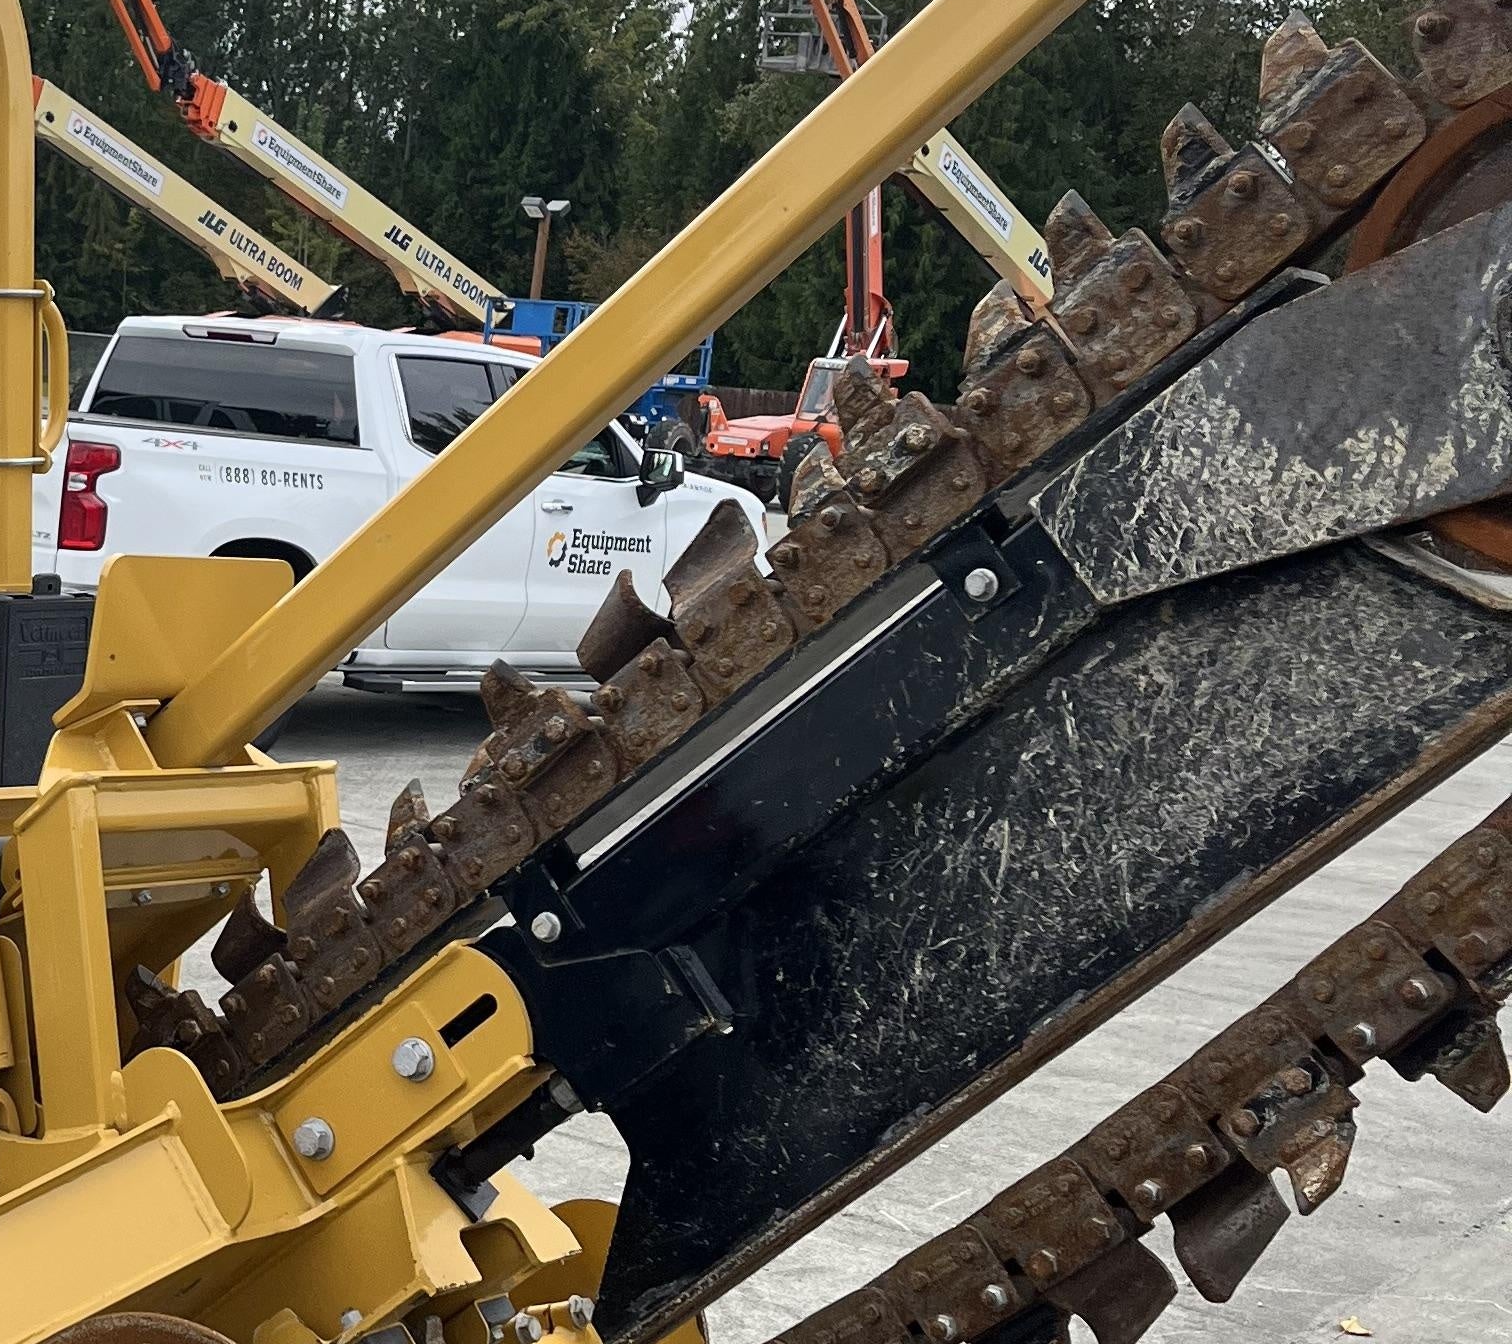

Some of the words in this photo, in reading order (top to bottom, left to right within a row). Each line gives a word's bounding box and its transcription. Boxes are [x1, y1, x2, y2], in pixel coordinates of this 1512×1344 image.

[83, 126, 158, 188] EquipmentShare
[268, 136, 342, 200] EquipmentShare
[951, 160, 1009, 231] EquipmentShare
[197, 210, 228, 236] JLG
[229, 228, 267, 266] ULTRA
[266, 256, 304, 291] BOOM
[384, 225, 414, 252] JLG
[415, 244, 453, 282] ULTRA
[452, 273, 489, 309] BOOM
[219, 466, 256, 485] (888)
[261, 470, 324, 490] 80-RENTS
[567, 553, 612, 575] Share
[571, 528, 652, 555] Equipment
